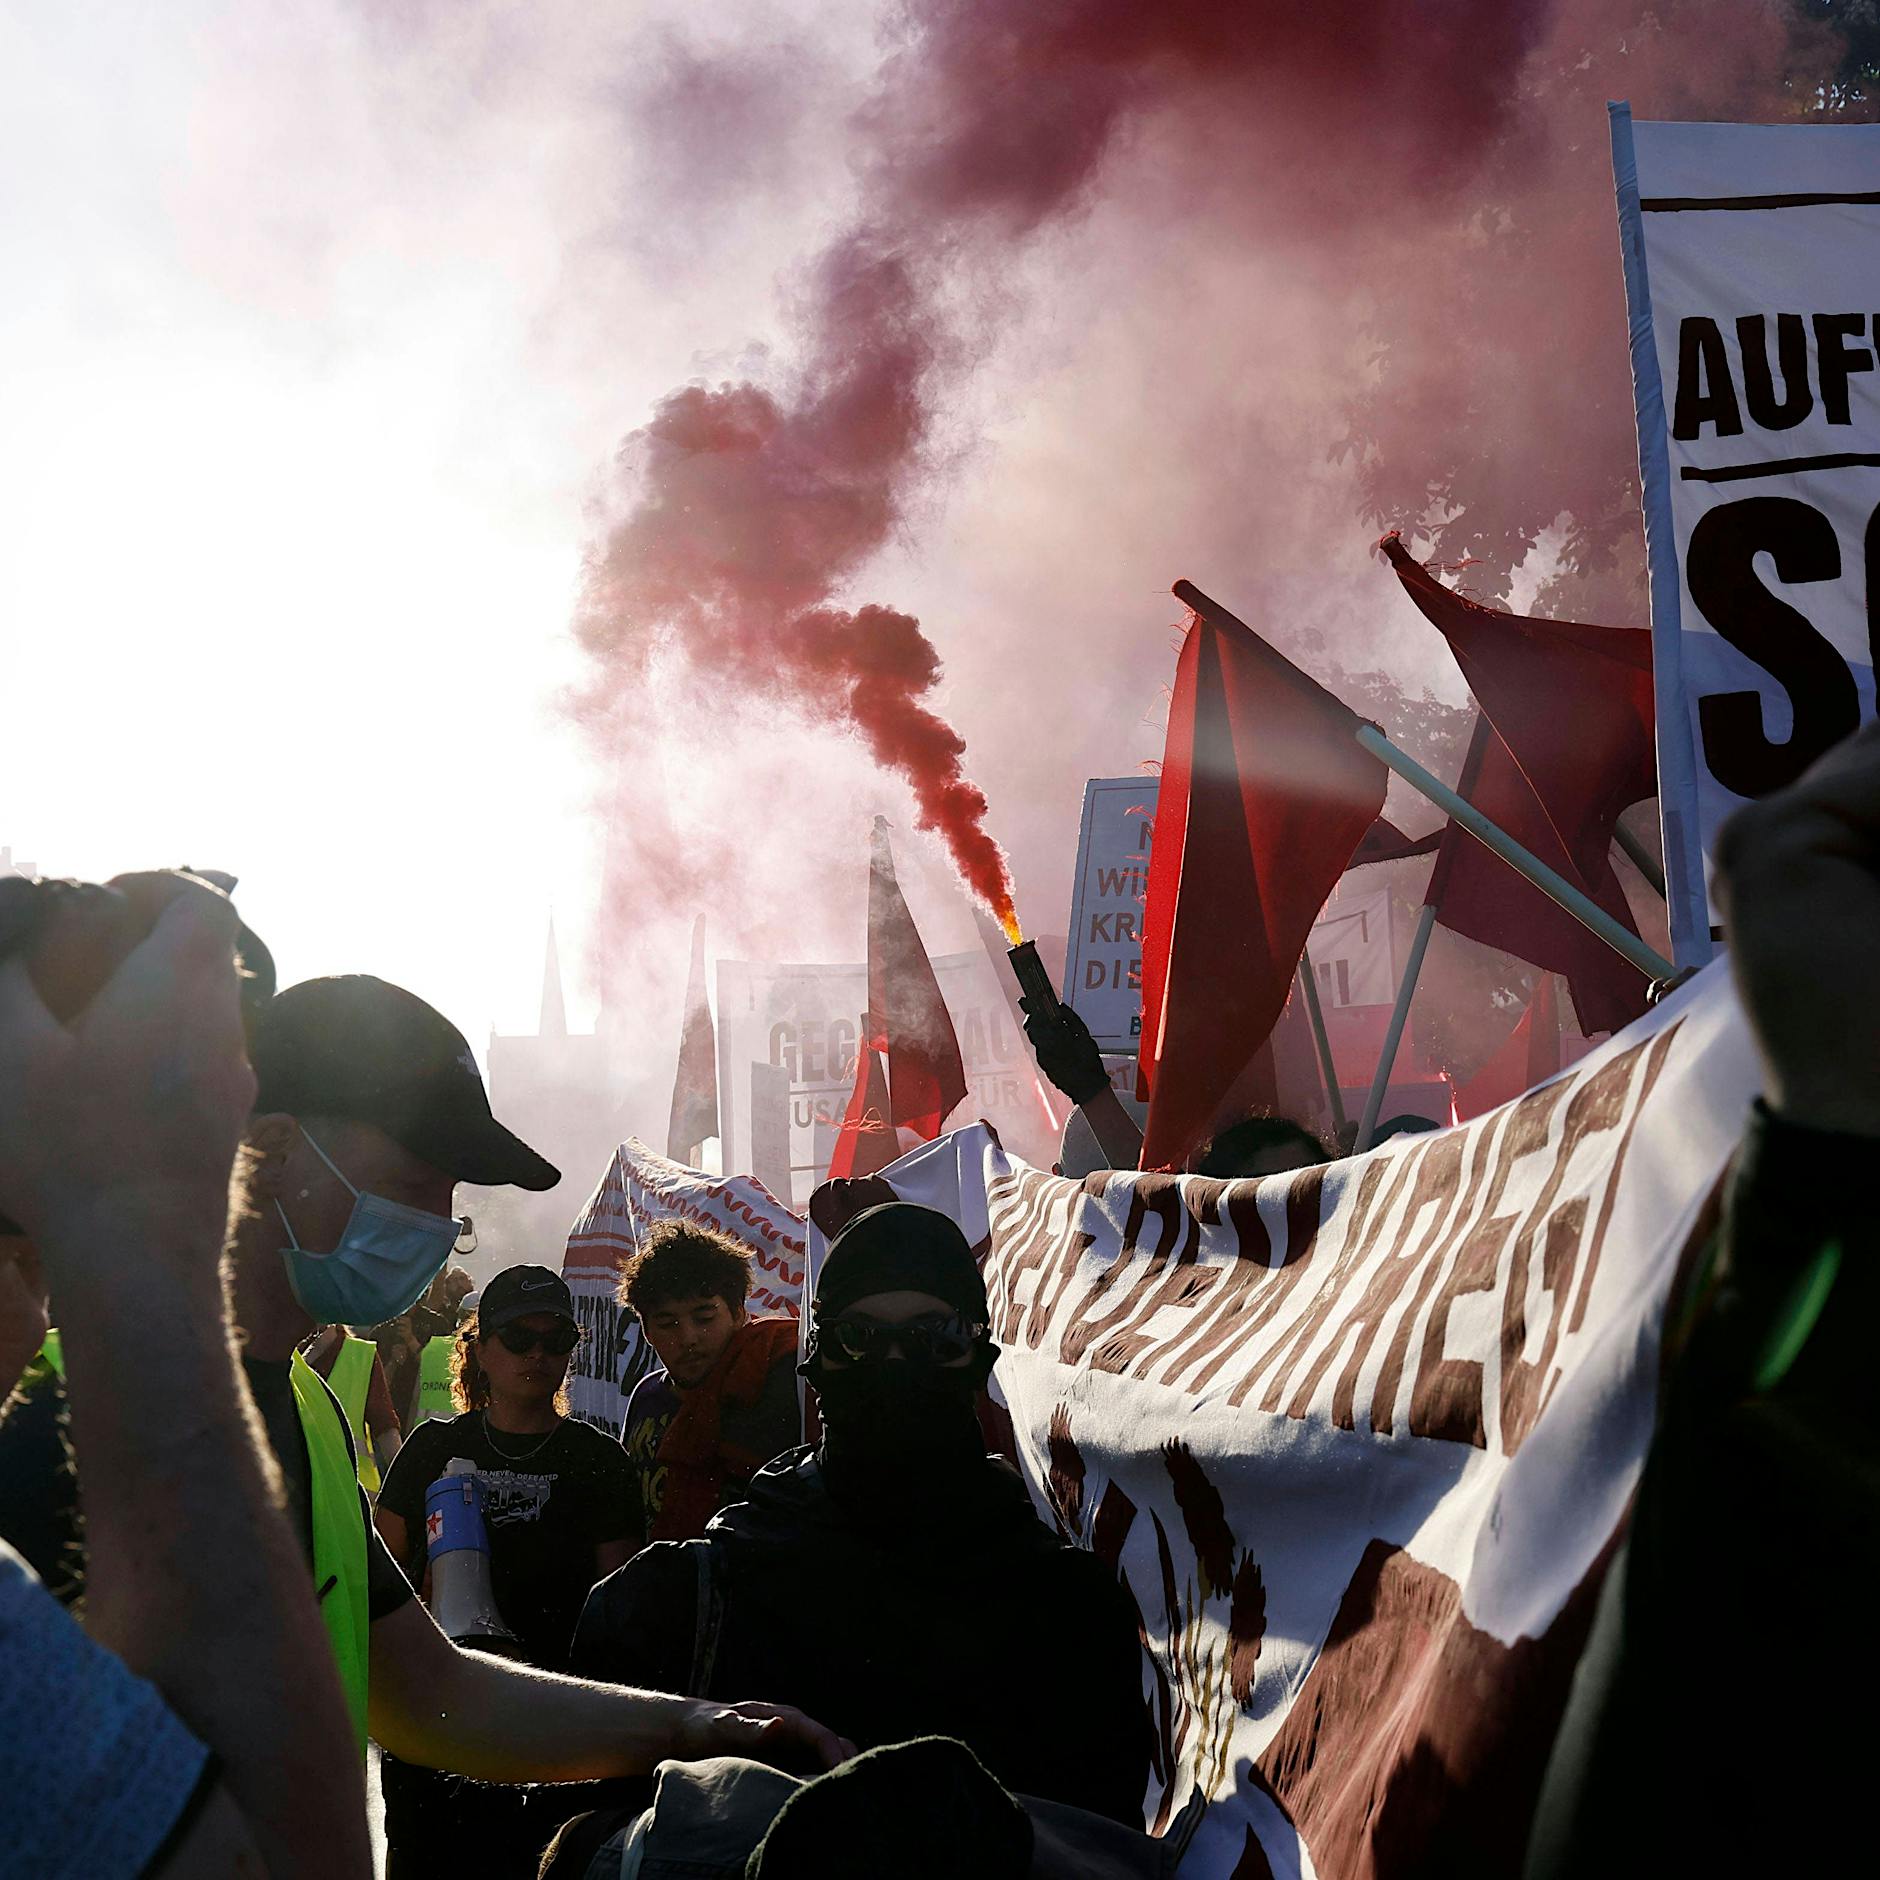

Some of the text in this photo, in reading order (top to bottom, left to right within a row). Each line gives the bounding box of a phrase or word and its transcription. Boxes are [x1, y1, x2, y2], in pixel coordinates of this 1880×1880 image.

[1673, 312, 1880, 441] AUF
[1686, 496, 1880, 800] S
[489, 1469, 515, 1478] NEVER
[517, 1473, 559, 1482] DEFEATED
